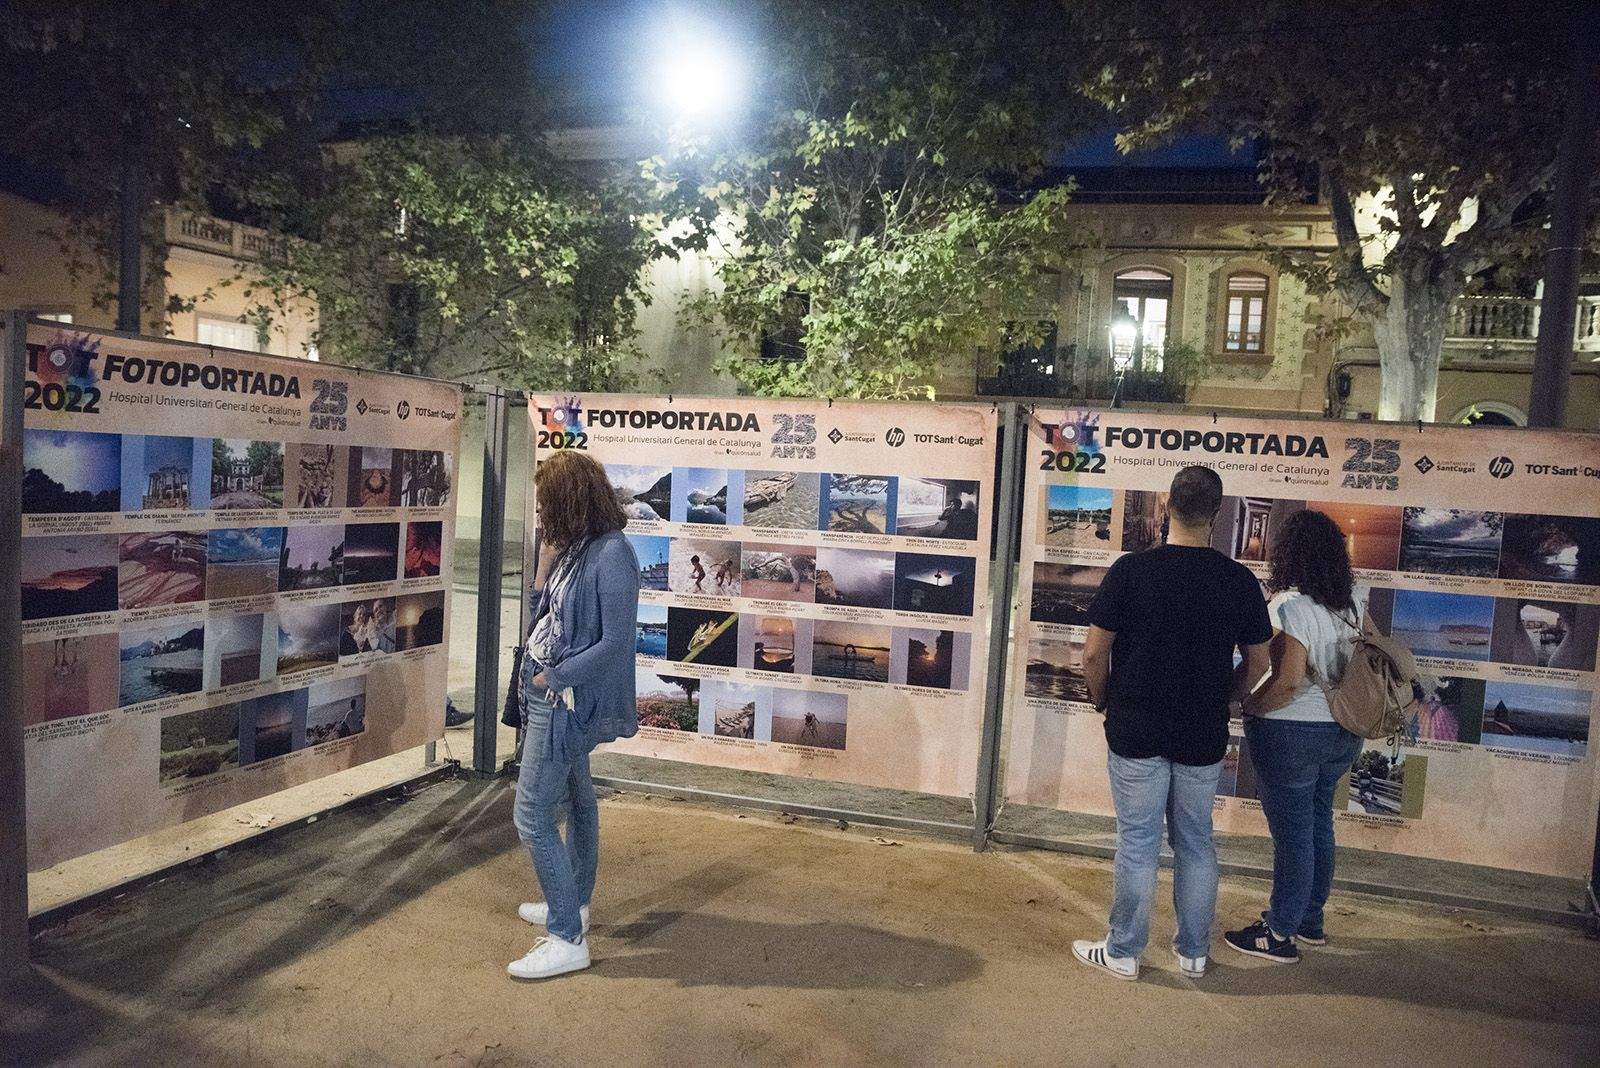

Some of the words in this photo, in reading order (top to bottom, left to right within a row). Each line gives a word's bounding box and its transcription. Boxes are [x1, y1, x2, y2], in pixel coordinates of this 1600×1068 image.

[26, 343, 98, 377] TOT
[102, 354, 302, 399] FOTOPORTADA
[24, 380, 100, 414] 2022
[109, 391, 152, 405] Hospital
[155, 394, 214, 409] Universitari
[216, 400, 248, 412] General
[250, 404, 260, 413] de
[262, 404, 302, 417] Catalunya
[309, 378, 349, 415] 25
[397, 400, 410, 420] hp
[538, 407, 582, 426] TOT
[586, 410, 760, 432] FOTOPORTADA
[308, 416, 348, 432] ANYS
[770, 413, 818, 445] 25
[537, 431, 588, 450] 2022
[593, 434, 624, 445] Hospital
[628, 434, 672, 444] Universitari
[674, 437, 705, 446] General
[706, 438, 718, 447] de
[720, 438, 762, 449] Catalunya
[844, 436, 876, 444] SantCugat
[886, 427, 906, 448] hp
[958, 436, 984, 447] Cugat
[1041, 423, 1098, 446] TOT
[1105, 426, 1330, 458] FOTOPORTADA
[770, 446, 816, 460] ANYS
[1040, 450, 1106, 474] 2022
[1342, 438, 1401, 475] 25
[1114, 456, 1155, 467] Hospital
[1158, 458, 1216, 469] Universitari
[1218, 460, 1258, 472] General
[1260, 464, 1274, 473] de
[1276, 463, 1330, 476] Catalunya
[1436, 465, 1476, 474] SantCugat
[1488, 456, 1514, 480] hp
[1340, 474, 1399, 492] ANYS
